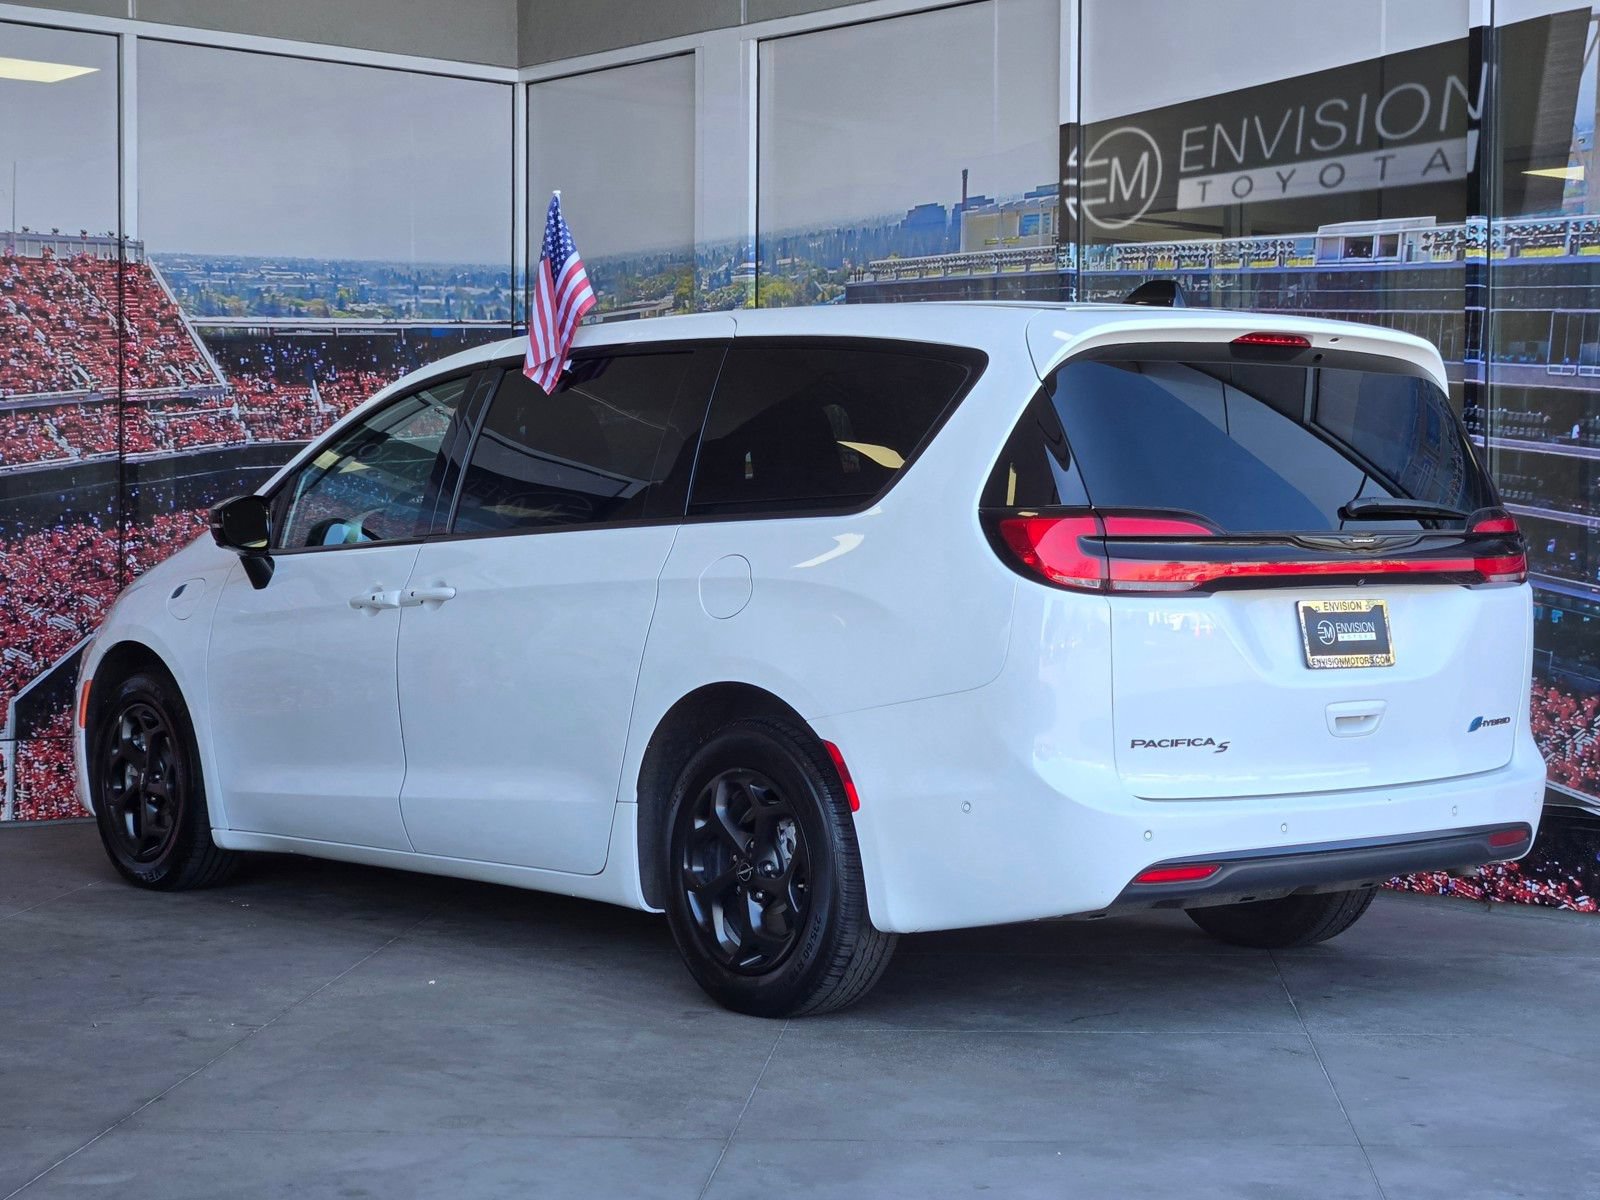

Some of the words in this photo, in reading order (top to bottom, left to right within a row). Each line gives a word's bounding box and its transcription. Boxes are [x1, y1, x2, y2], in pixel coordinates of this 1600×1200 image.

[1180, 61, 1488, 172] ENVISION
[1197, 147, 1453, 202] TOYOTA
[1323, 602, 1362, 611] ENVISION
[1336, 622, 1375, 633] ENVISION
[1311, 655, 1391, 666] ENVISIONMOTORS.COM
[1130, 737, 1216, 749] PACIFICA
[1213, 741, 1231, 754] S
[803, 912, 822, 960] 235/60
